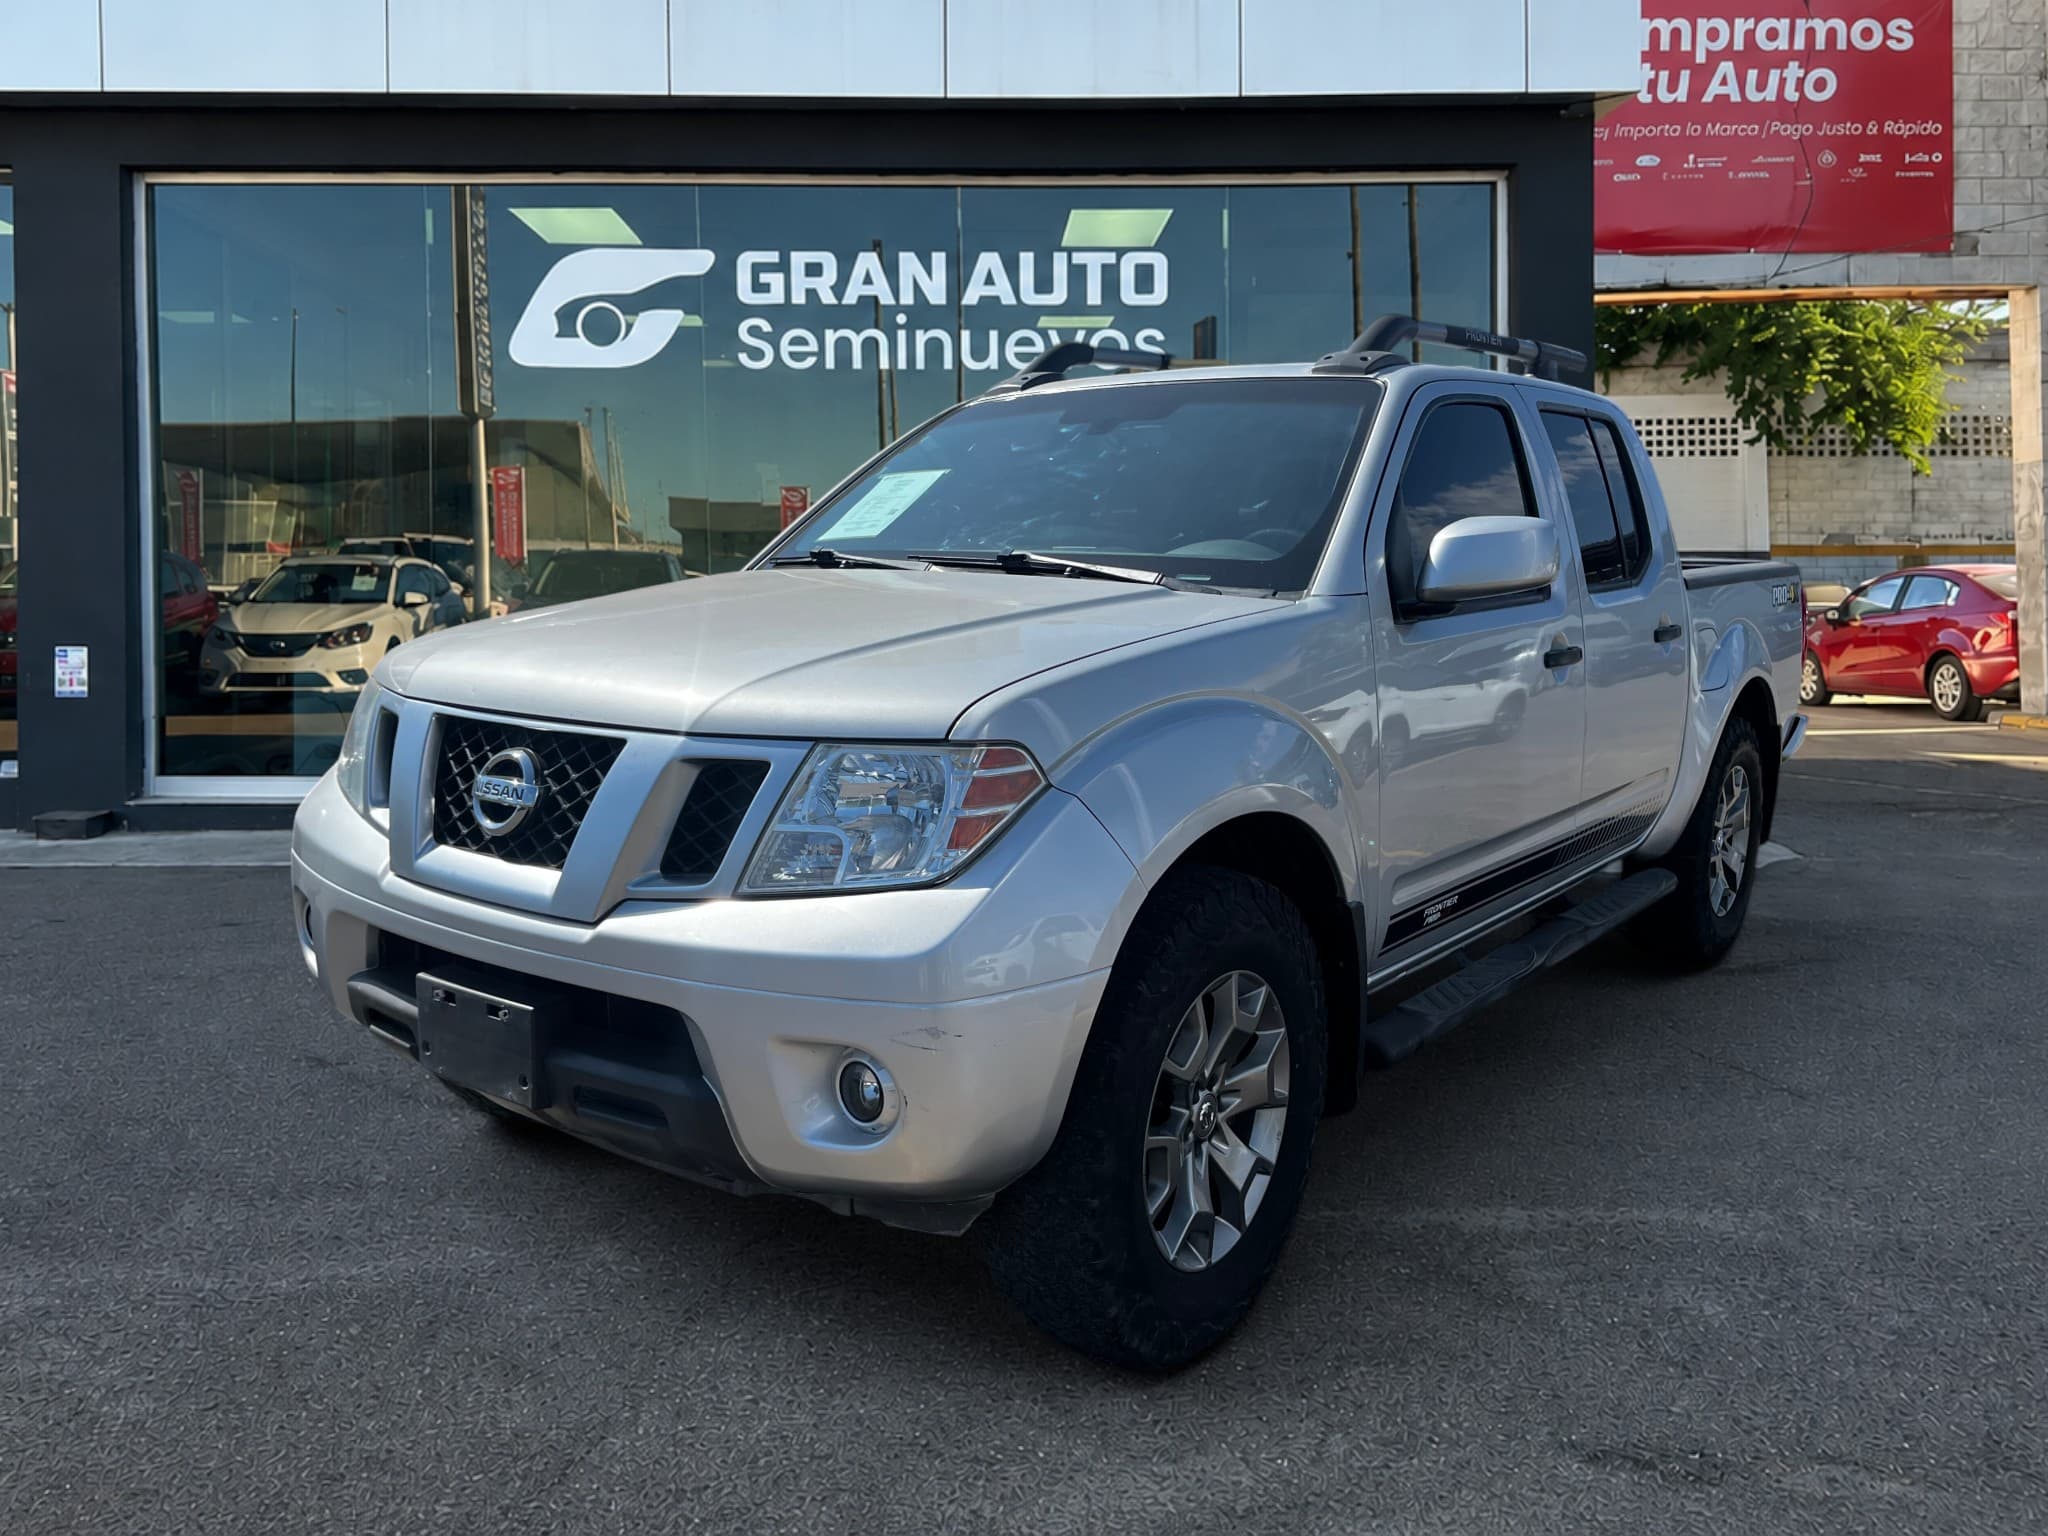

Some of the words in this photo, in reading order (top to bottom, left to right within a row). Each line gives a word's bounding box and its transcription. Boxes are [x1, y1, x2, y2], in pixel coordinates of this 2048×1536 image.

[1641, 17, 1915, 63] mpramos
[1637, 61, 1691, 103] tu
[1701, 60, 1838, 103] Auto
[1614, 122, 1681, 141] Importa
[1705, 122, 1760, 137] Marca
[1817, 120, 1863, 137] Justo
[736, 250, 948, 306] GRAN
[962, 251, 1169, 307] AUTO
[1424, 895, 1458, 918] FRONTIER
